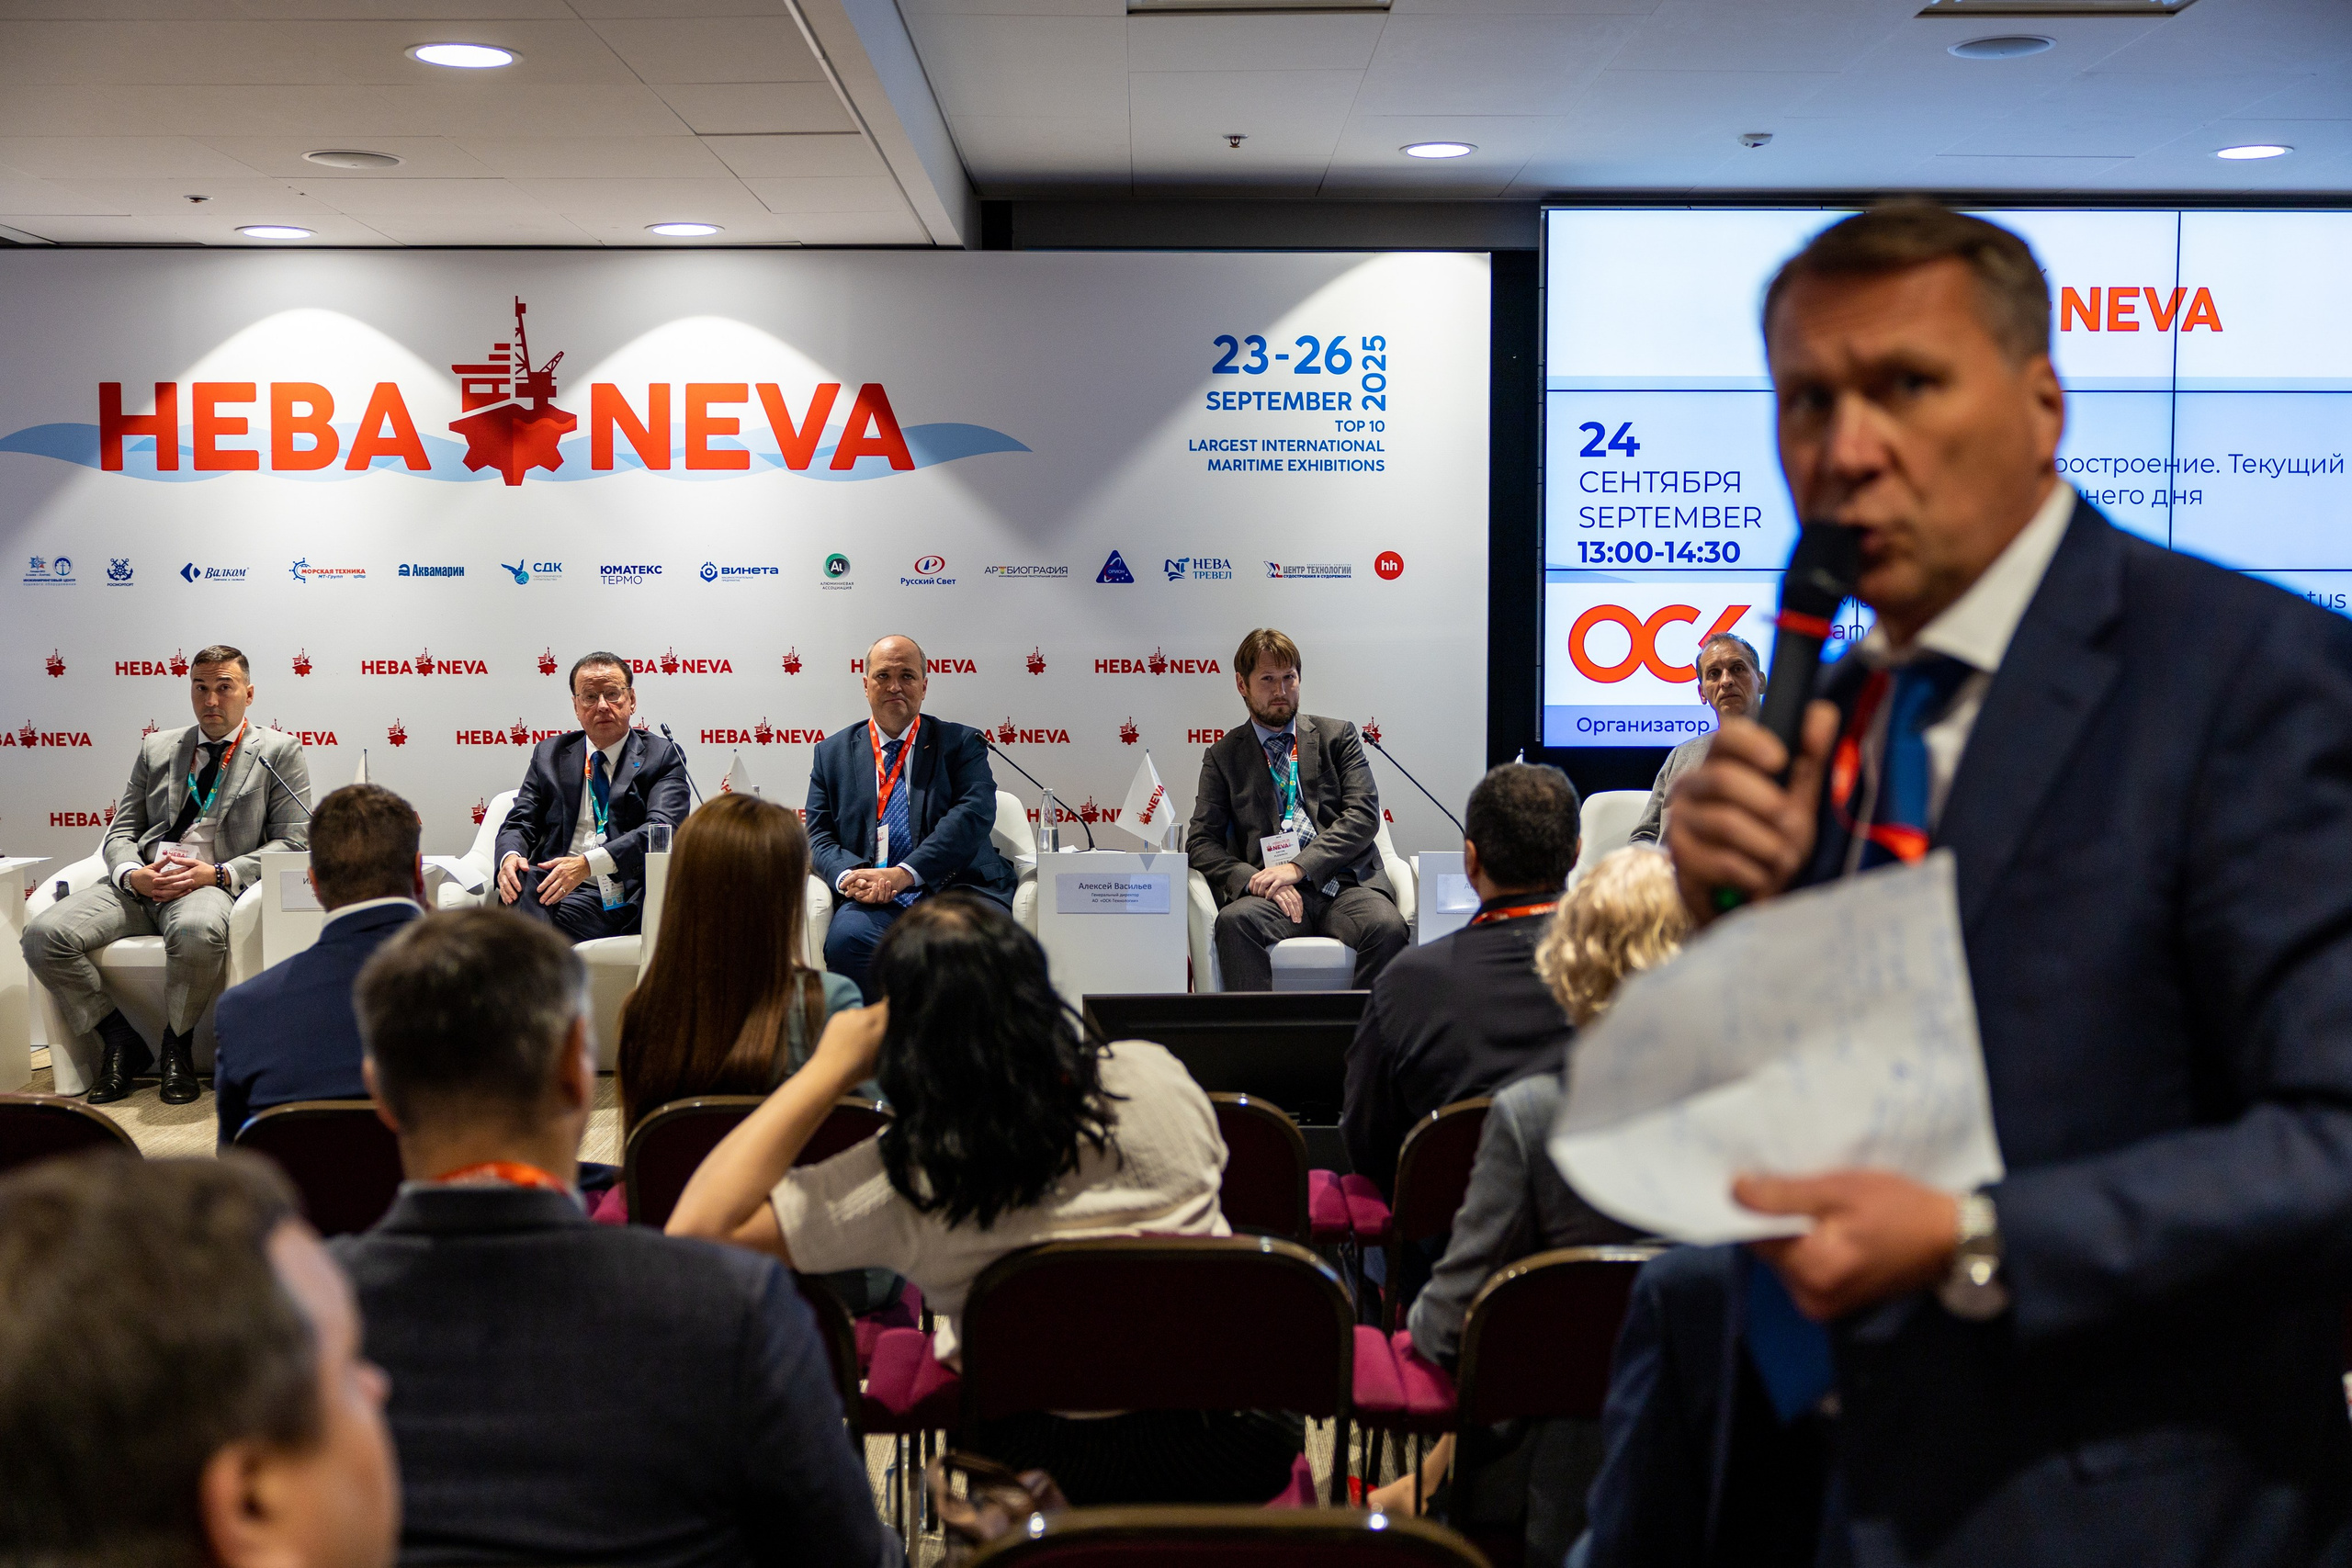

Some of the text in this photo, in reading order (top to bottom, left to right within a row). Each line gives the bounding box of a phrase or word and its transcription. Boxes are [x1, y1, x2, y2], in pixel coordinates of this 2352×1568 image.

[2061, 287, 2223, 333] NEVA
[1212, 334, 1352, 375] 23-26
[1362, 335, 1386, 411] 2025
[1206, 391, 1351, 411] SEPTEMBER
[98, 382, 432, 471] НЕВА
[591, 383, 916, 470] NEVA
[1335, 420, 1385, 432] TOP 10
[1189, 439, 1385, 452] LARGEST INTERNATIONAL
[1578, 422, 1641, 457] 24
[1208, 459, 1385, 471] MARITIME EXHIBITIONS
[2228, 453, 2344, 479] Текущий
[1579, 471, 1741, 493] СЕНТЯБРЯ
[2151, 490, 2202, 508] дня
[1578, 506, 1762, 529] SEPTEMBER
[1577, 541, 1741, 563] 13:00-14:30
[413, 564, 464, 578] Аквамарин
[533, 562, 562, 572] СДК
[600, 566, 662, 574] ЮМАТЕКС
[984, 566, 1069, 574] АРТБИОГРАФИЯ
[1193, 558, 1231, 570] НЕВА
[1283, 566, 1305, 574] ЦЕНТР
[1381, 559, 1397, 570] hh
[601, 576, 642, 584] ТЕРМО
[900, 577, 956, 586] Русский Свет
[1193, 570, 1232, 580] ТРЕВЕЛ
[115, 661, 167, 676] НЕВА
[361, 660, 413, 675] НЕВА
[437, 660, 488, 674] NEVA
[683, 660, 733, 673] NEVA
[927, 660, 978, 673] NEVA
[1094, 659, 1146, 673] НЕВА
[1170, 660, 1220, 673] NEVA
[1577, 716, 1710, 736] Организатор
[41, 732, 93, 747] NEVA
[457, 730, 507, 745] НЕВА
[701, 729, 752, 744] НЕВА
[776, 729, 826, 744] NEVA
[1020, 729, 1070, 743] NEVA
[1188, 729, 1225, 743] НЕВ
[1146, 784, 1165, 814] NEVA
[50, 812, 102, 827] НЕВА
[1079, 882, 1152, 890] Алексей Васильев
